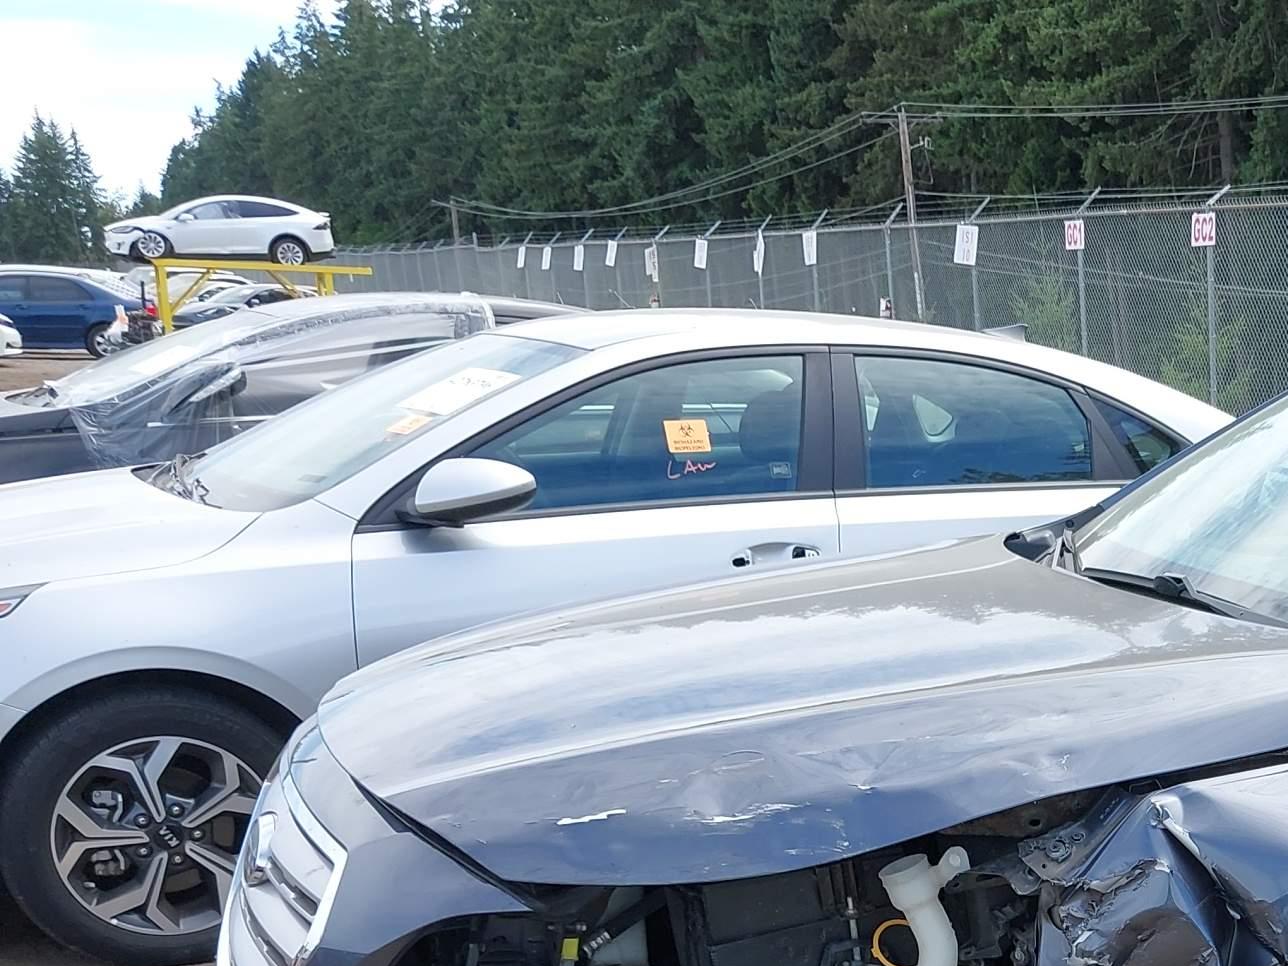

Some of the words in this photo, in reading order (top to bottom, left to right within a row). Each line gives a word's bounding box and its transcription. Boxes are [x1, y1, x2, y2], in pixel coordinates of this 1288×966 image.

[1067, 223, 1082, 246] GC1
[1193, 216, 1214, 243] GC2
[159, 825, 180, 847] KIA
